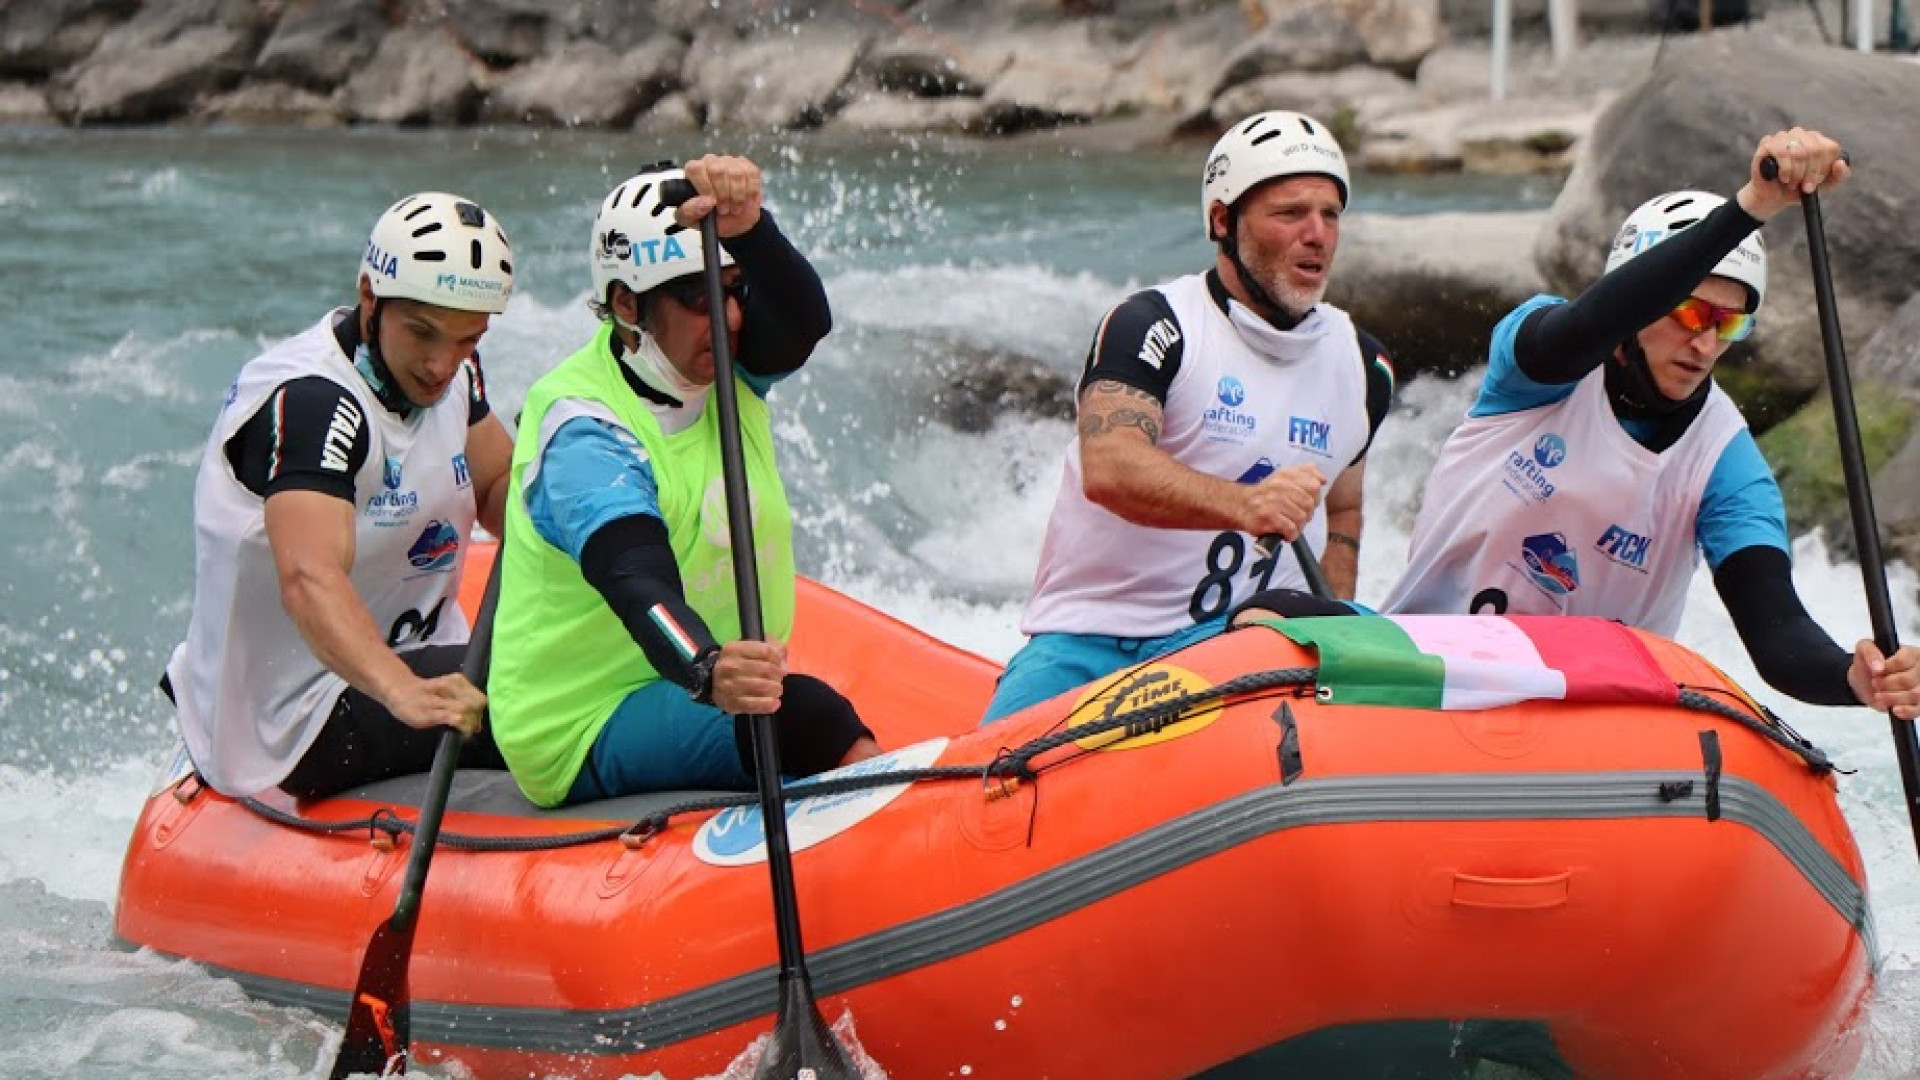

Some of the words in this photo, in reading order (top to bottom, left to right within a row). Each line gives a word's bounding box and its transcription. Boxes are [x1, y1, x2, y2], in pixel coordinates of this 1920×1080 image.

[632, 236, 686, 267] ITA
[1633, 230, 1663, 253] IT
[1137, 318, 1180, 370] ITALIA
[320, 396, 363, 472] ITALIA
[1203, 407, 1256, 430] rafting
[1289, 416, 1331, 451] FFCK
[452, 454, 467, 486] FF
[1509, 450, 1555, 498] rafting
[367, 491, 418, 507] rafting
[1597, 524, 1652, 566] FFCK
[1189, 531, 1284, 624] 81
